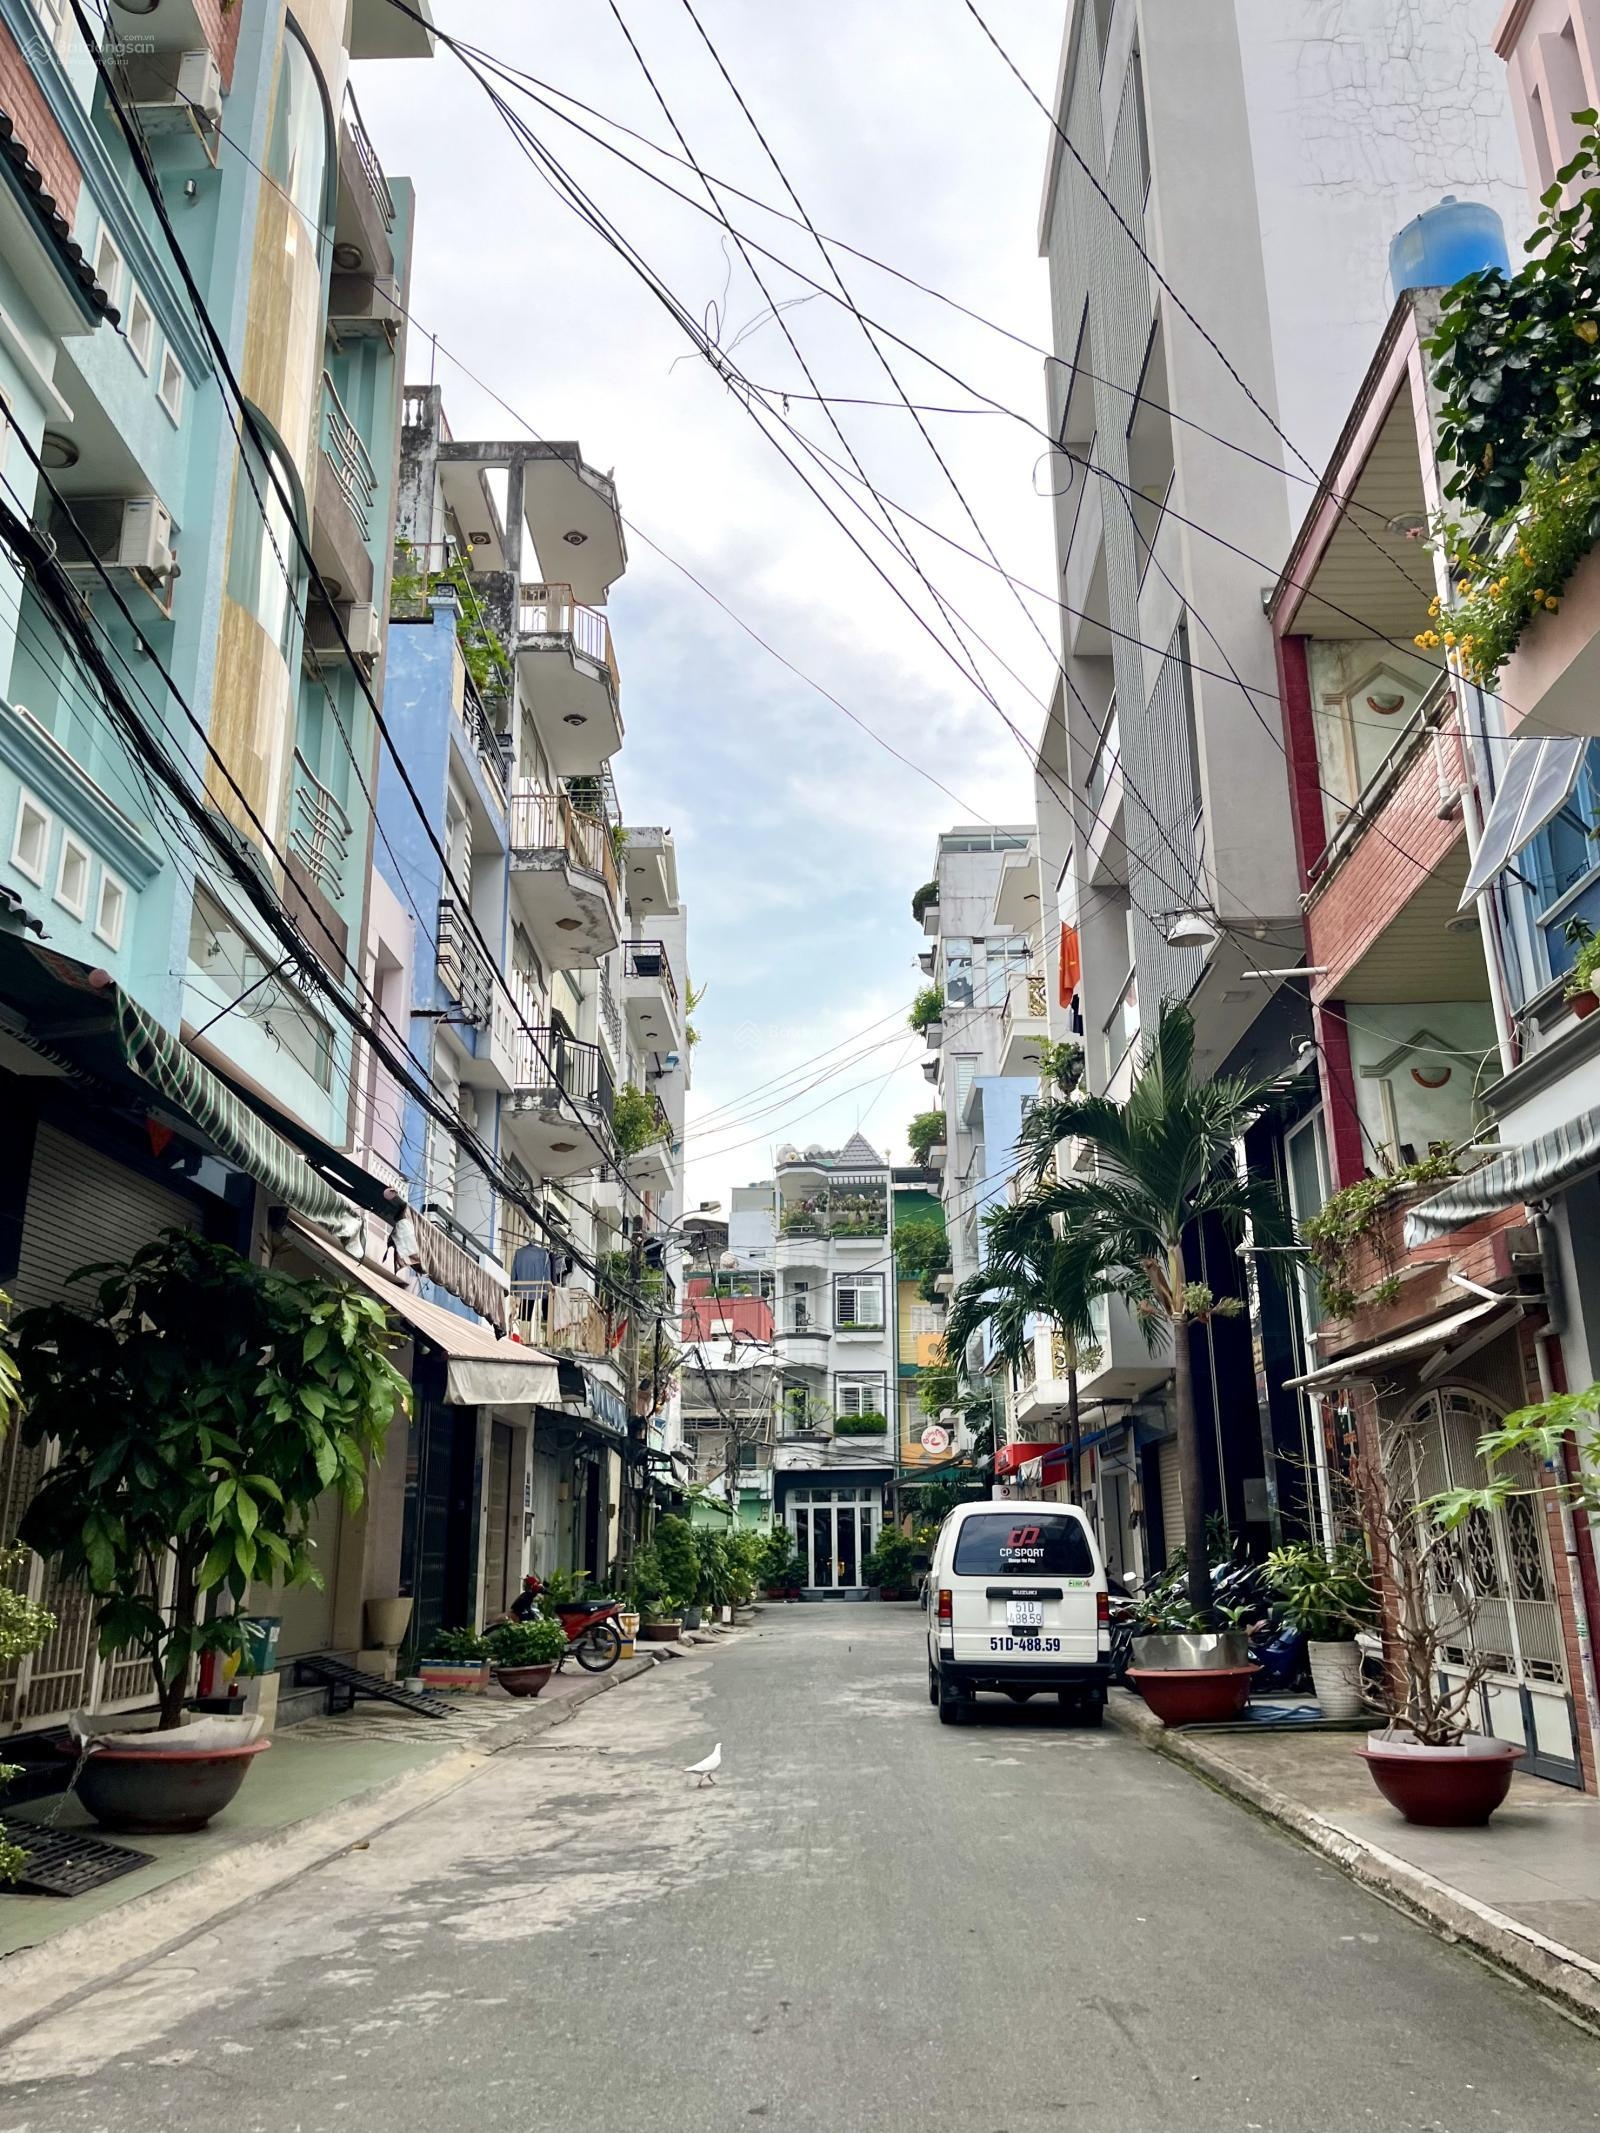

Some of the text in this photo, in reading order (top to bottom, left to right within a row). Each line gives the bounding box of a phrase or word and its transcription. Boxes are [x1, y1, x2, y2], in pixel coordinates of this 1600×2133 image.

[999, 1548, 1045, 1557] CP SPORT
[1016, 1602, 1034, 1612] 51D
[990, 1637, 1061, 1652] 51D-488.59
